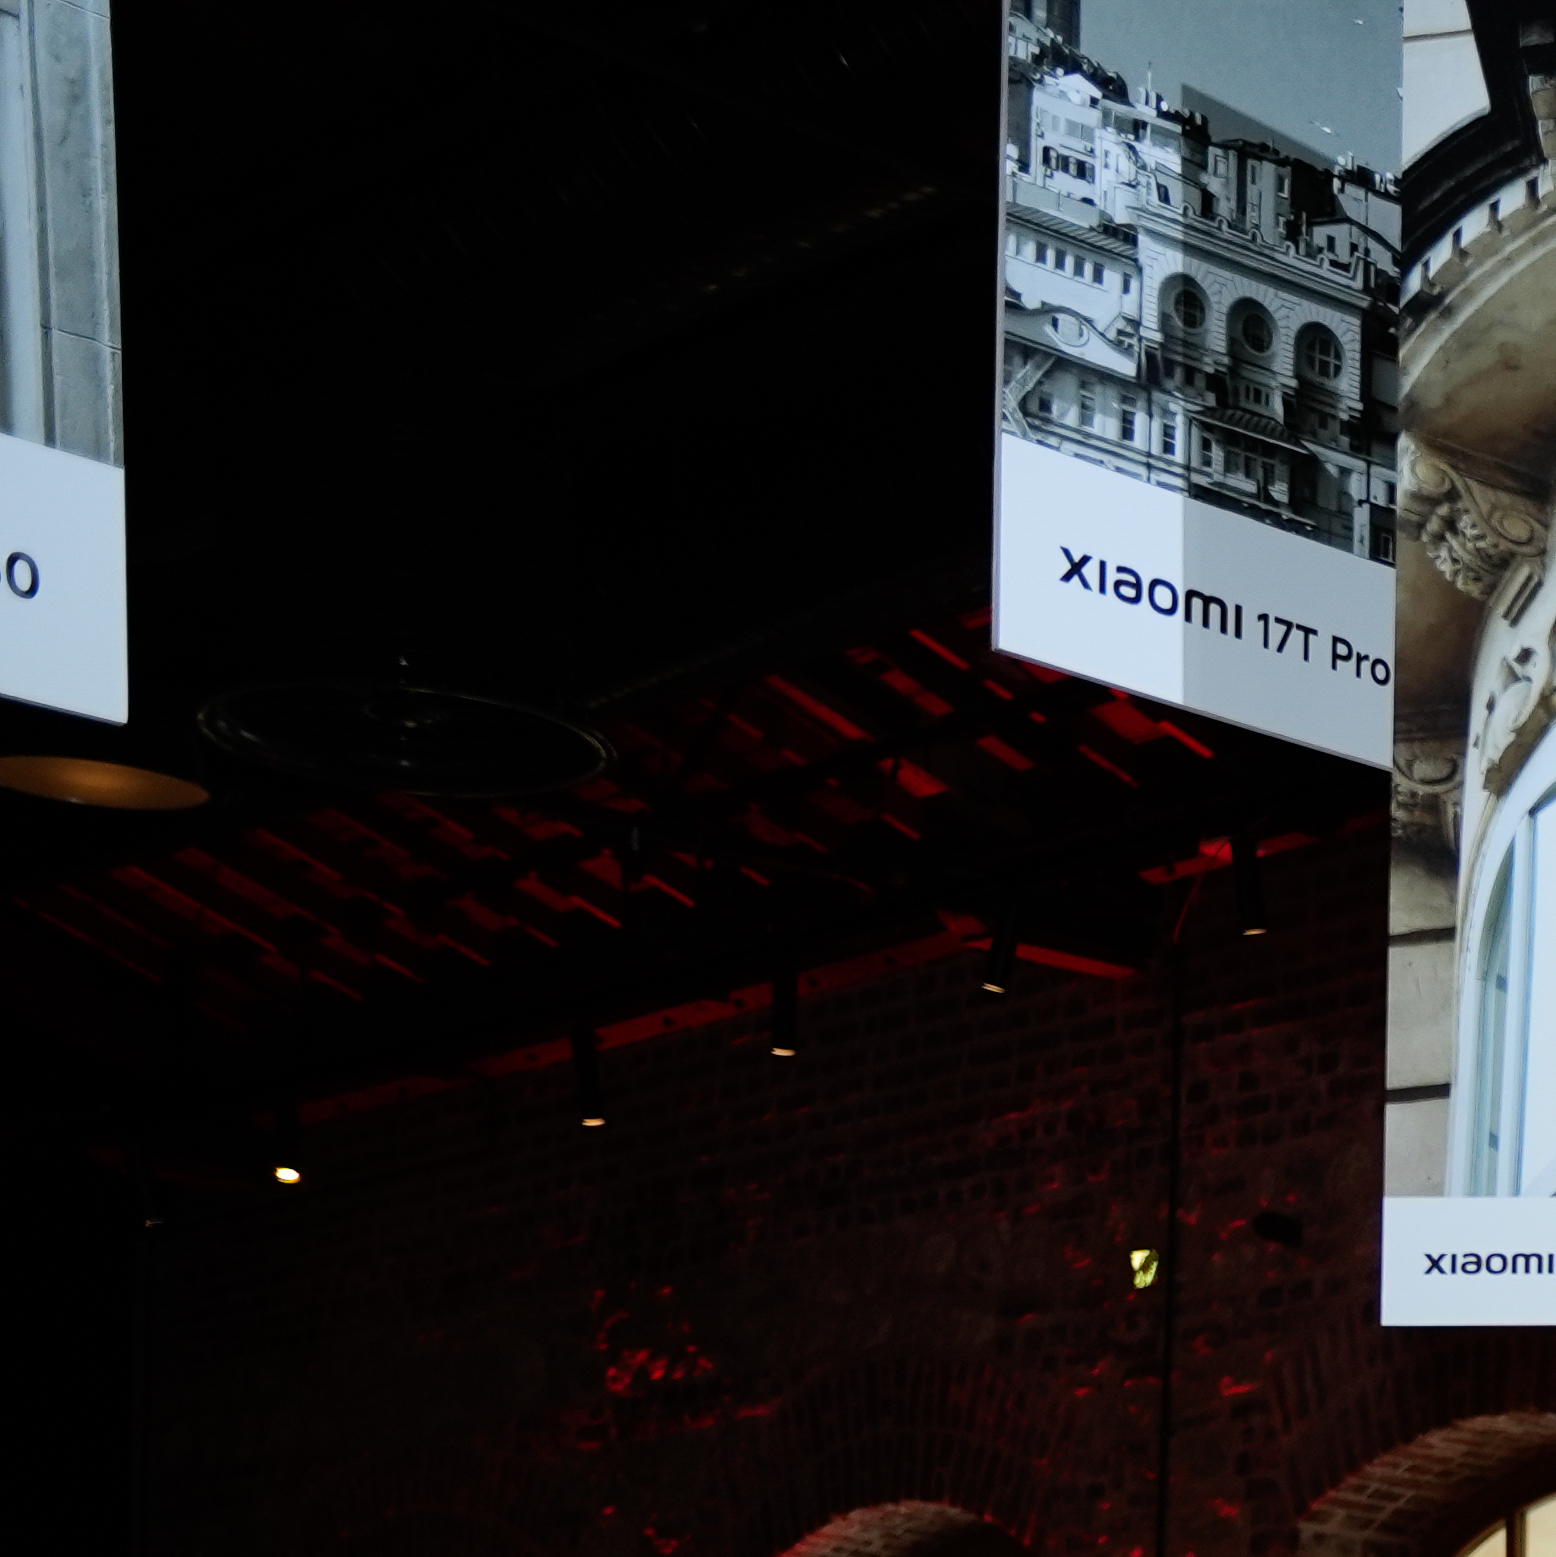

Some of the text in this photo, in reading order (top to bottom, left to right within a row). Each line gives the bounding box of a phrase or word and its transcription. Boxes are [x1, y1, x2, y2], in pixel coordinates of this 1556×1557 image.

[1060, 546, 1391, 686] xiaomi 17T Pro
[1424, 1252, 1554, 1275] xiaomi
